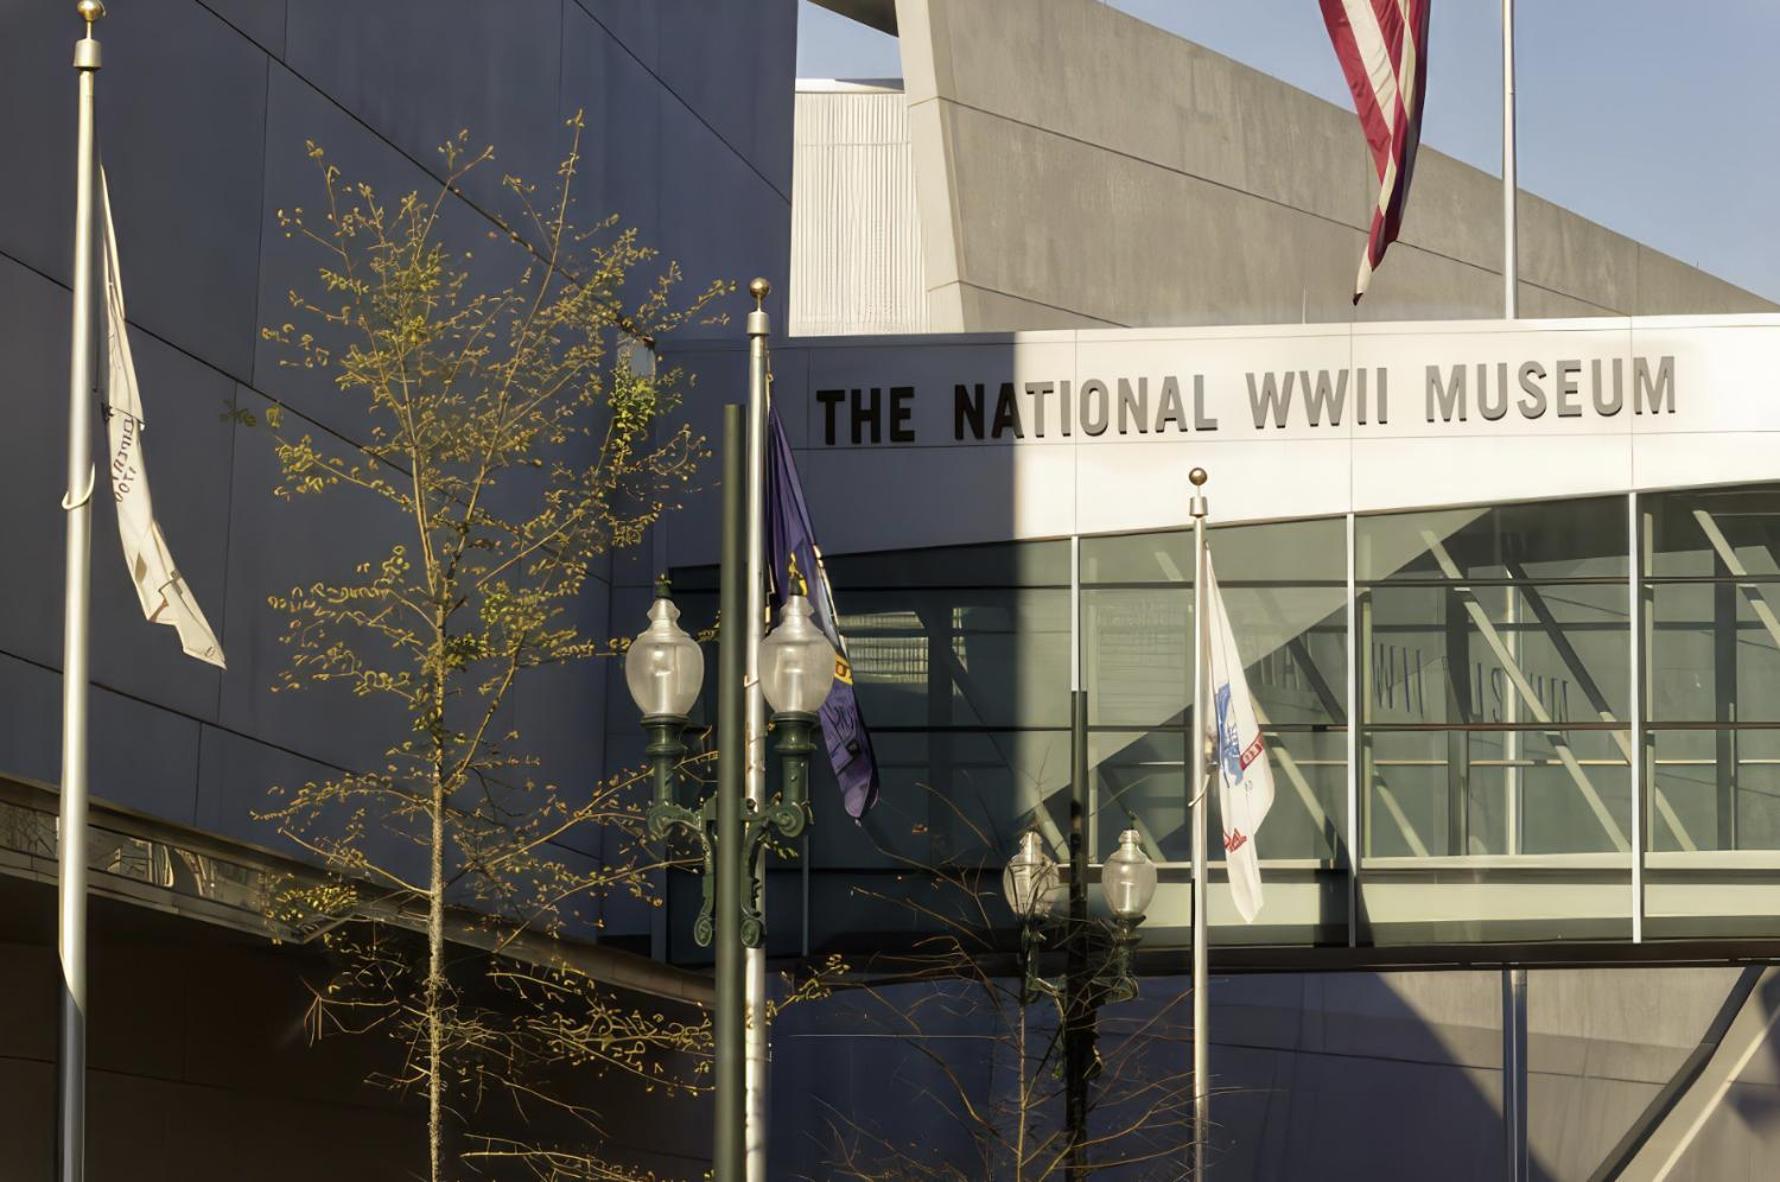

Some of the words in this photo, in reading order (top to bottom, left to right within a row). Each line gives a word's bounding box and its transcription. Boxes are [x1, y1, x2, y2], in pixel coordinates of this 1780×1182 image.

[816, 386, 915, 446] THE
[954, 374, 1219, 441] NATIONAL
[1245, 367, 1389, 430] WWII
[1425, 355, 1677, 423] MUSEUM
